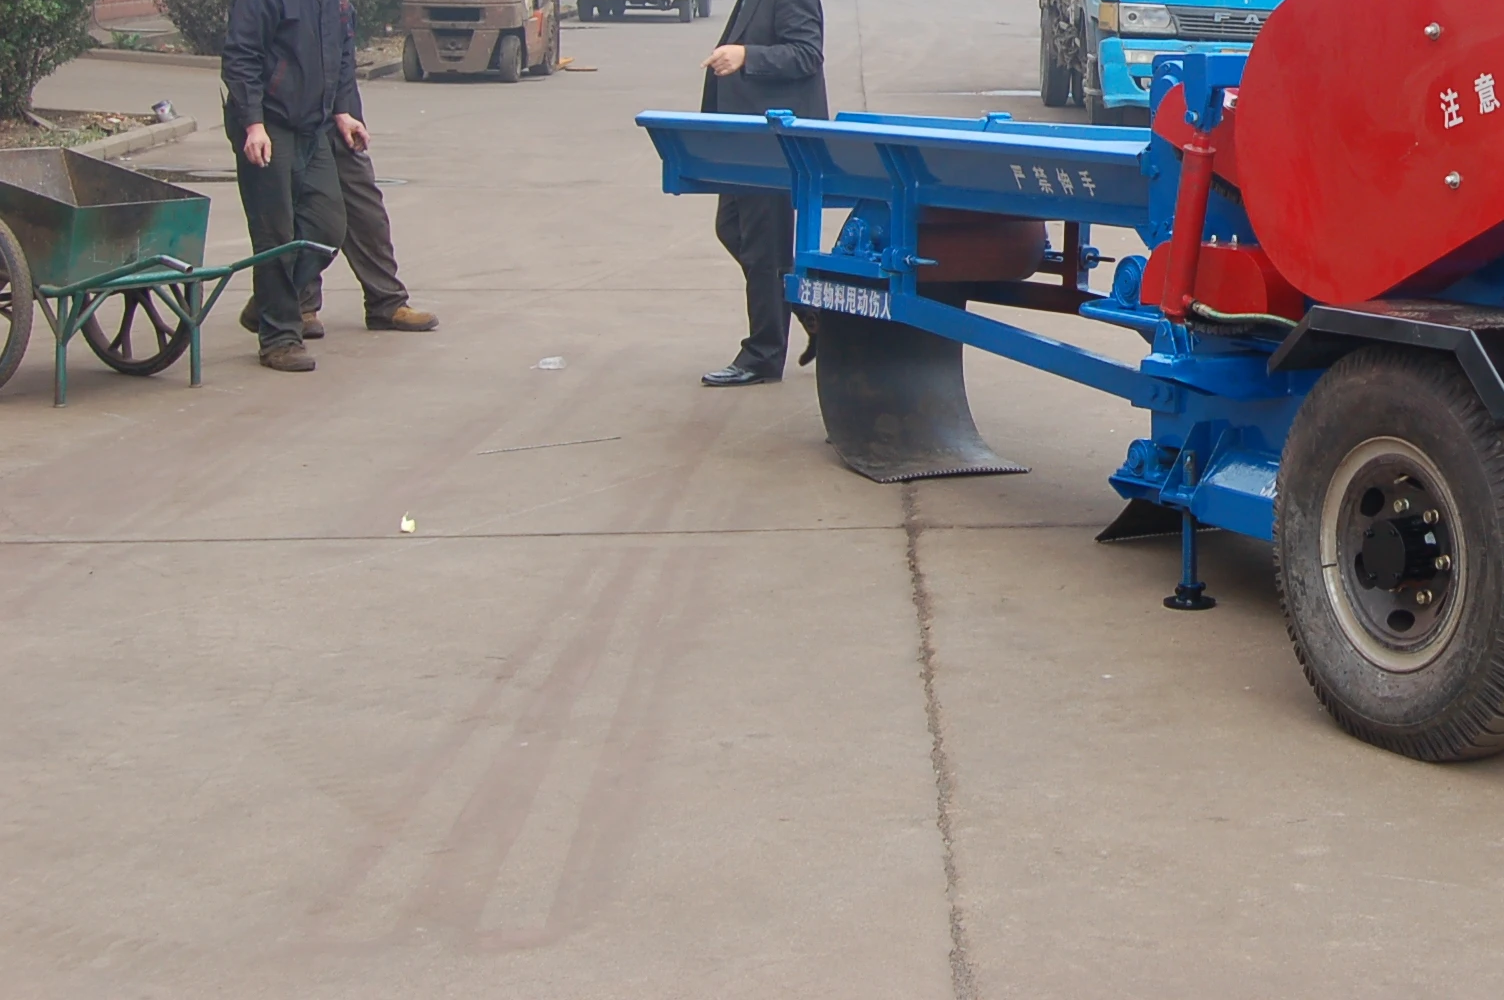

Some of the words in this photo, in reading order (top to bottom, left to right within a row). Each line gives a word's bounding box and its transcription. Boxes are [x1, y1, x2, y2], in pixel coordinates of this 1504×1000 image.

[1214, 12, 1260, 24] FA
[1009, 164, 1096, 197] 严禁伸手
[800, 278, 892, 320] 注意物料甩动伤人
